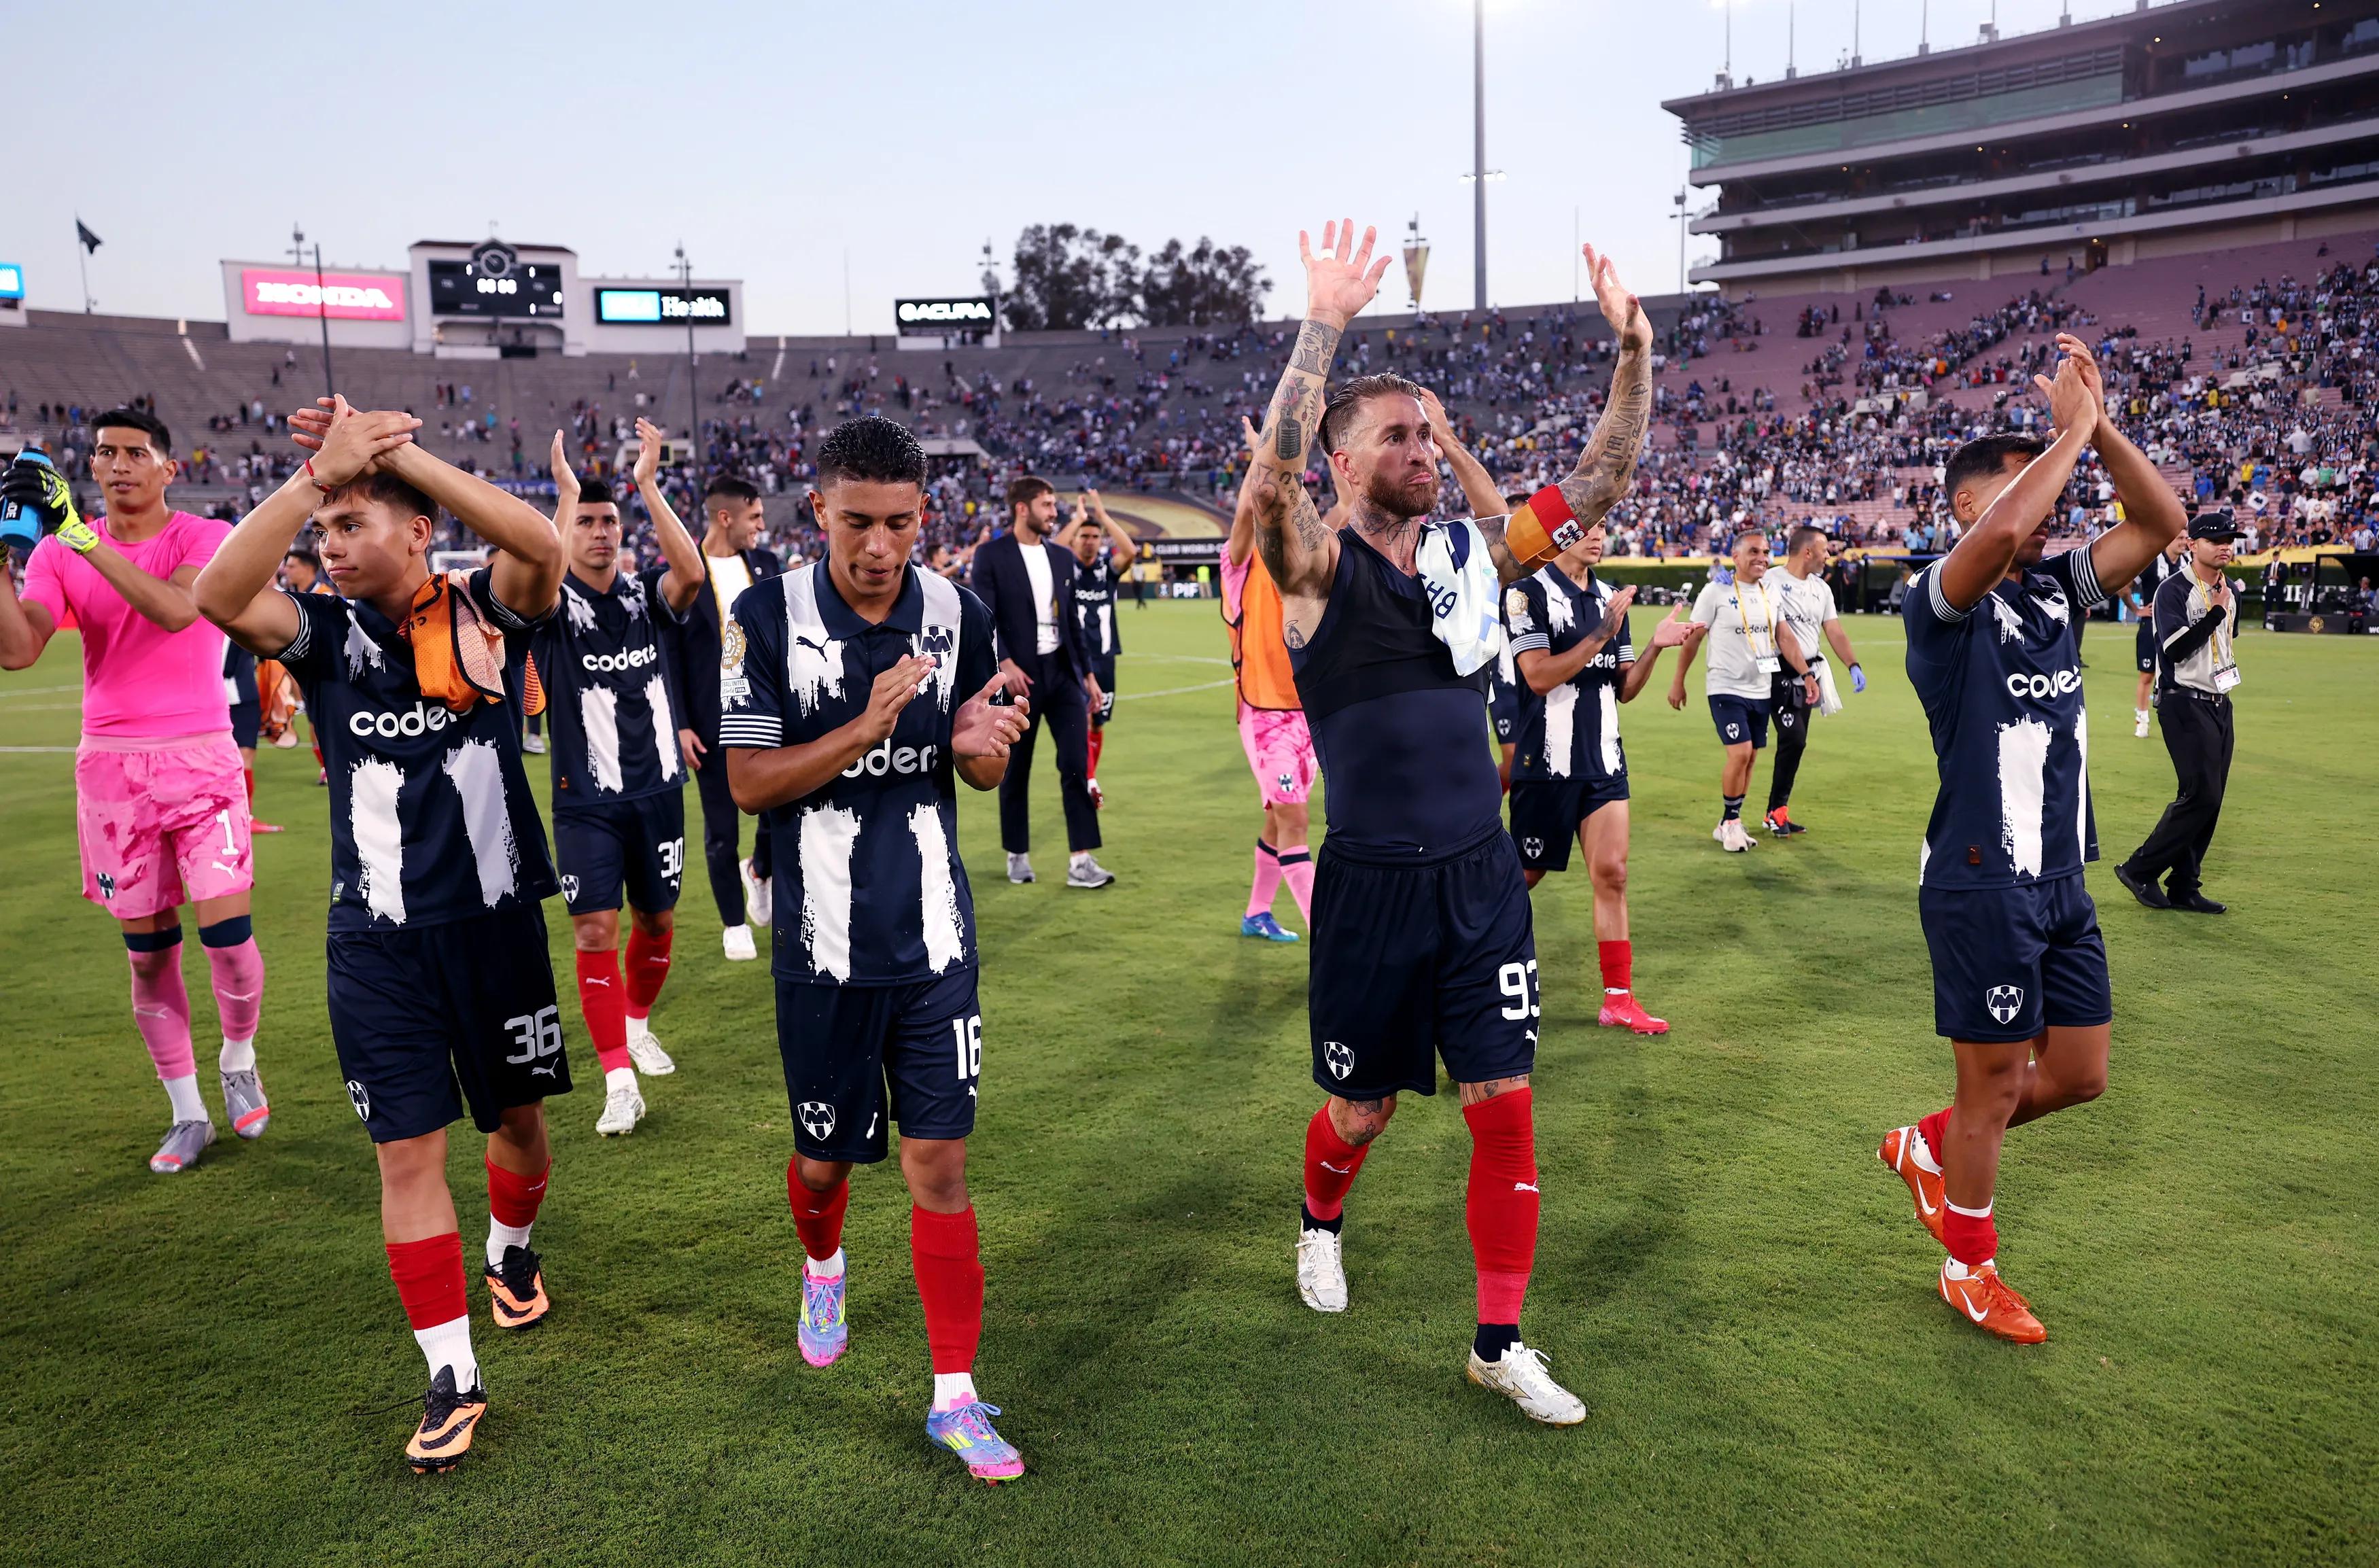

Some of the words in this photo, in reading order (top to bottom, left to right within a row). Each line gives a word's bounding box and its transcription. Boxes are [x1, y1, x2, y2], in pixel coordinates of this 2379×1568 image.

[256, 282, 393, 308] HONDA
[917, 302, 992, 320] ACURA
[1156, 544, 1181, 555] CLUB
[1181, 543, 1215, 555] WORLD
[1173, 582, 1199, 598] PIF
[723, 657, 733, 666] FIFA
[1585, 652, 1616, 669] ere
[2007, 665, 2081, 699] coe
[349, 701, 474, 738] code
[841, 738, 938, 778] oder
[215, 809, 240, 856] 1
[657, 836, 684, 878] 30
[504, 1004, 562, 1064] 36
[952, 1014, 982, 1080] 16
